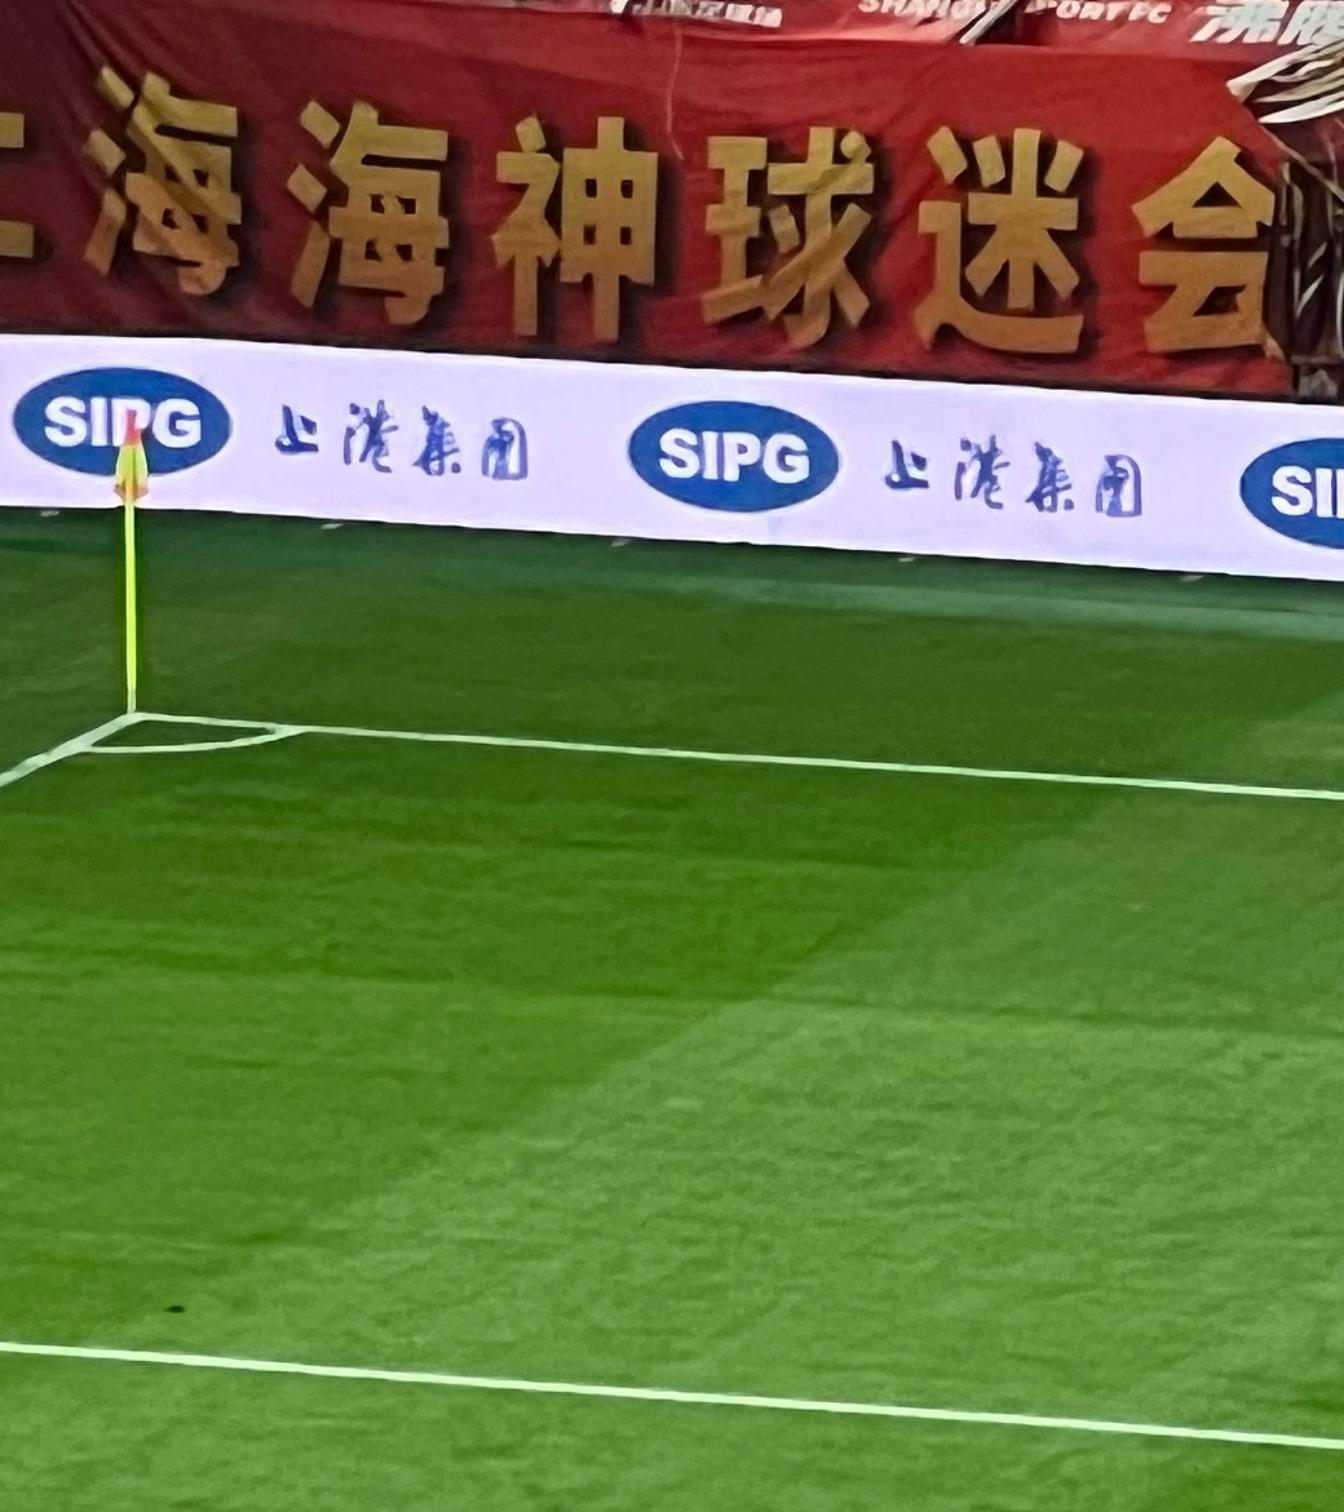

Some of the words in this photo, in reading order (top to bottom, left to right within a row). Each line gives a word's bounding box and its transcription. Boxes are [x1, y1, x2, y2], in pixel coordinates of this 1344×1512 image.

[44, 395, 202, 449] SIPG
[658, 427, 811, 485] SIPG
[1271, 465, 1344, 519] SI
